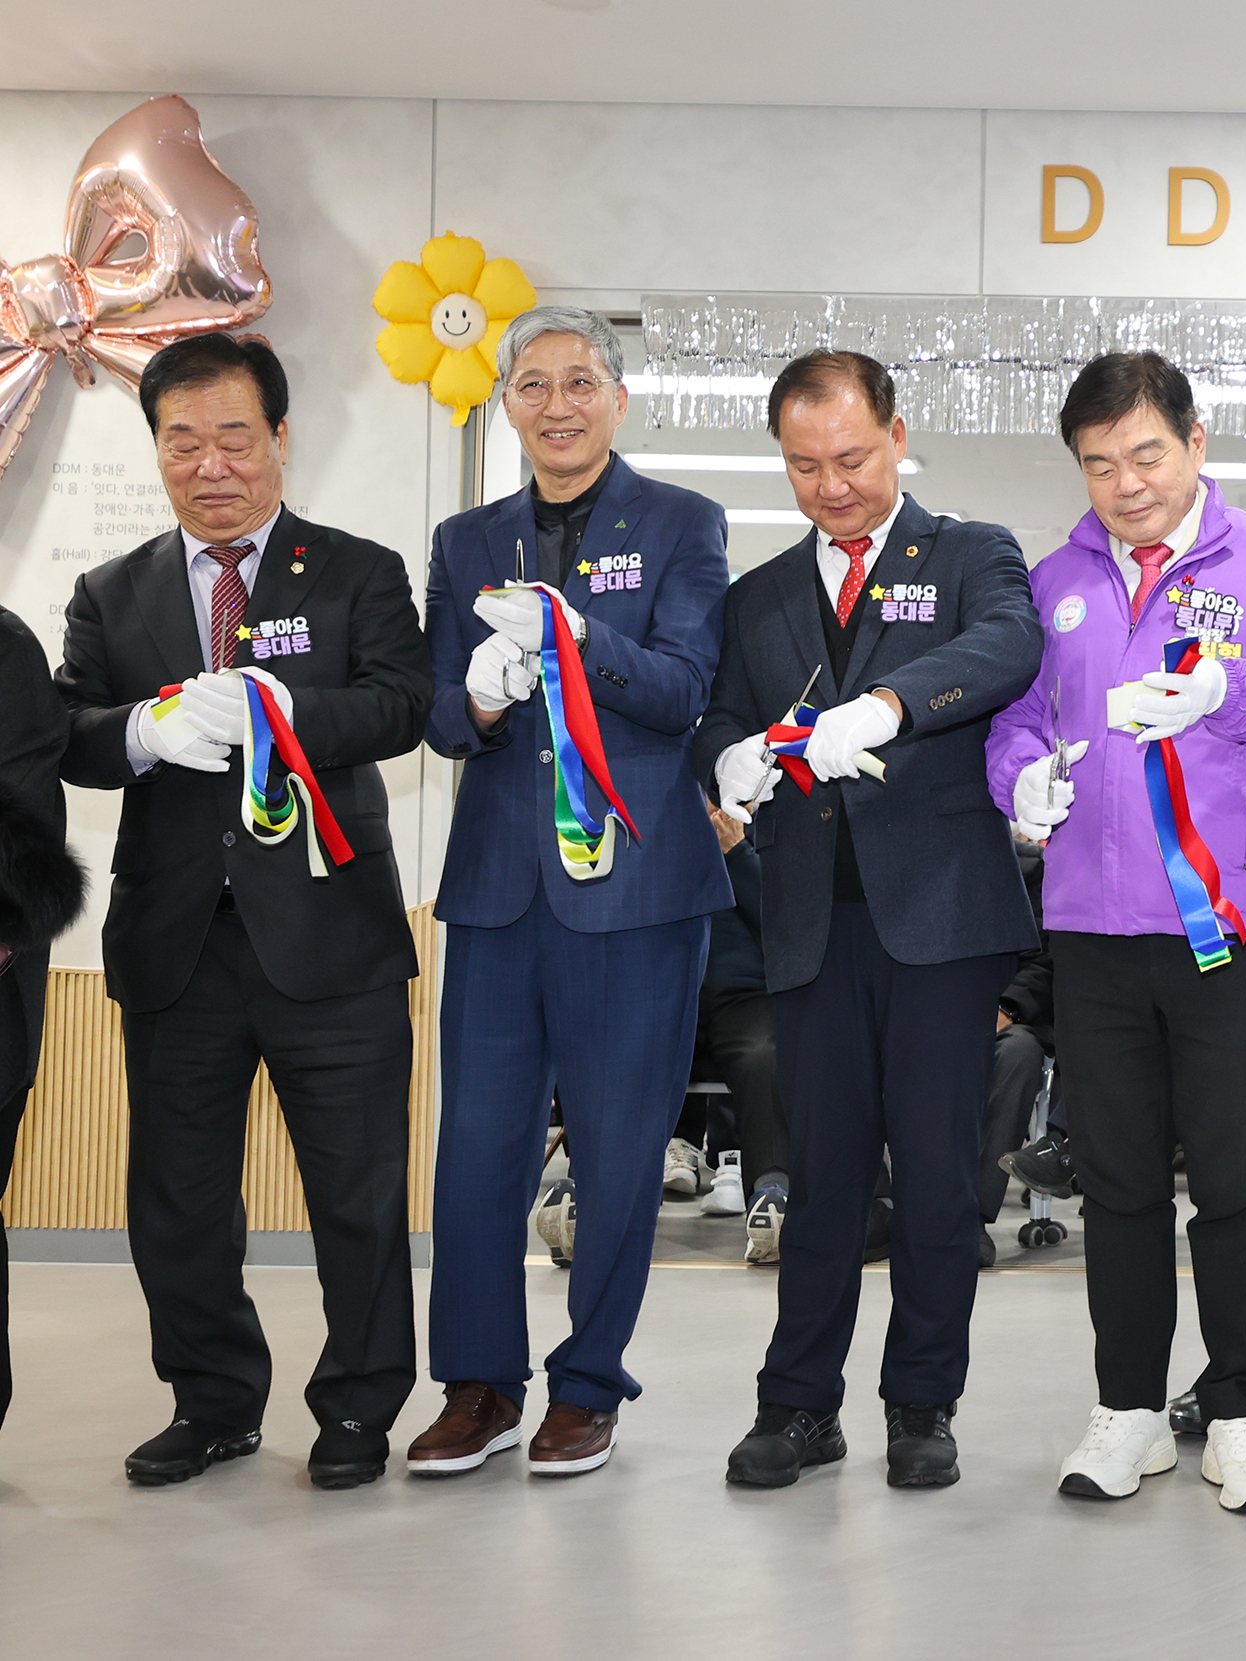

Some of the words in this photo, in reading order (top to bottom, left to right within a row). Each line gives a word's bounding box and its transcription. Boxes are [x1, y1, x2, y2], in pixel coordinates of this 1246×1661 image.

[52, 463, 81, 474] DDM
[91, 463, 126, 477] 동대문
[93, 522, 151, 536] 공간이라는
[51, 547, 91, 561] 홀(Hall)
[598, 552, 643, 573] 좋아요
[589, 569, 642, 594] 동대문
[892, 584, 938, 602] 좋아요
[1189, 589, 1237, 615] 좋아요
[880, 601, 936, 622] 동대문
[1175, 605, 1234, 636] 동대문
[259, 616, 310, 638] 좋아요
[251, 632, 311, 659] 동대문
